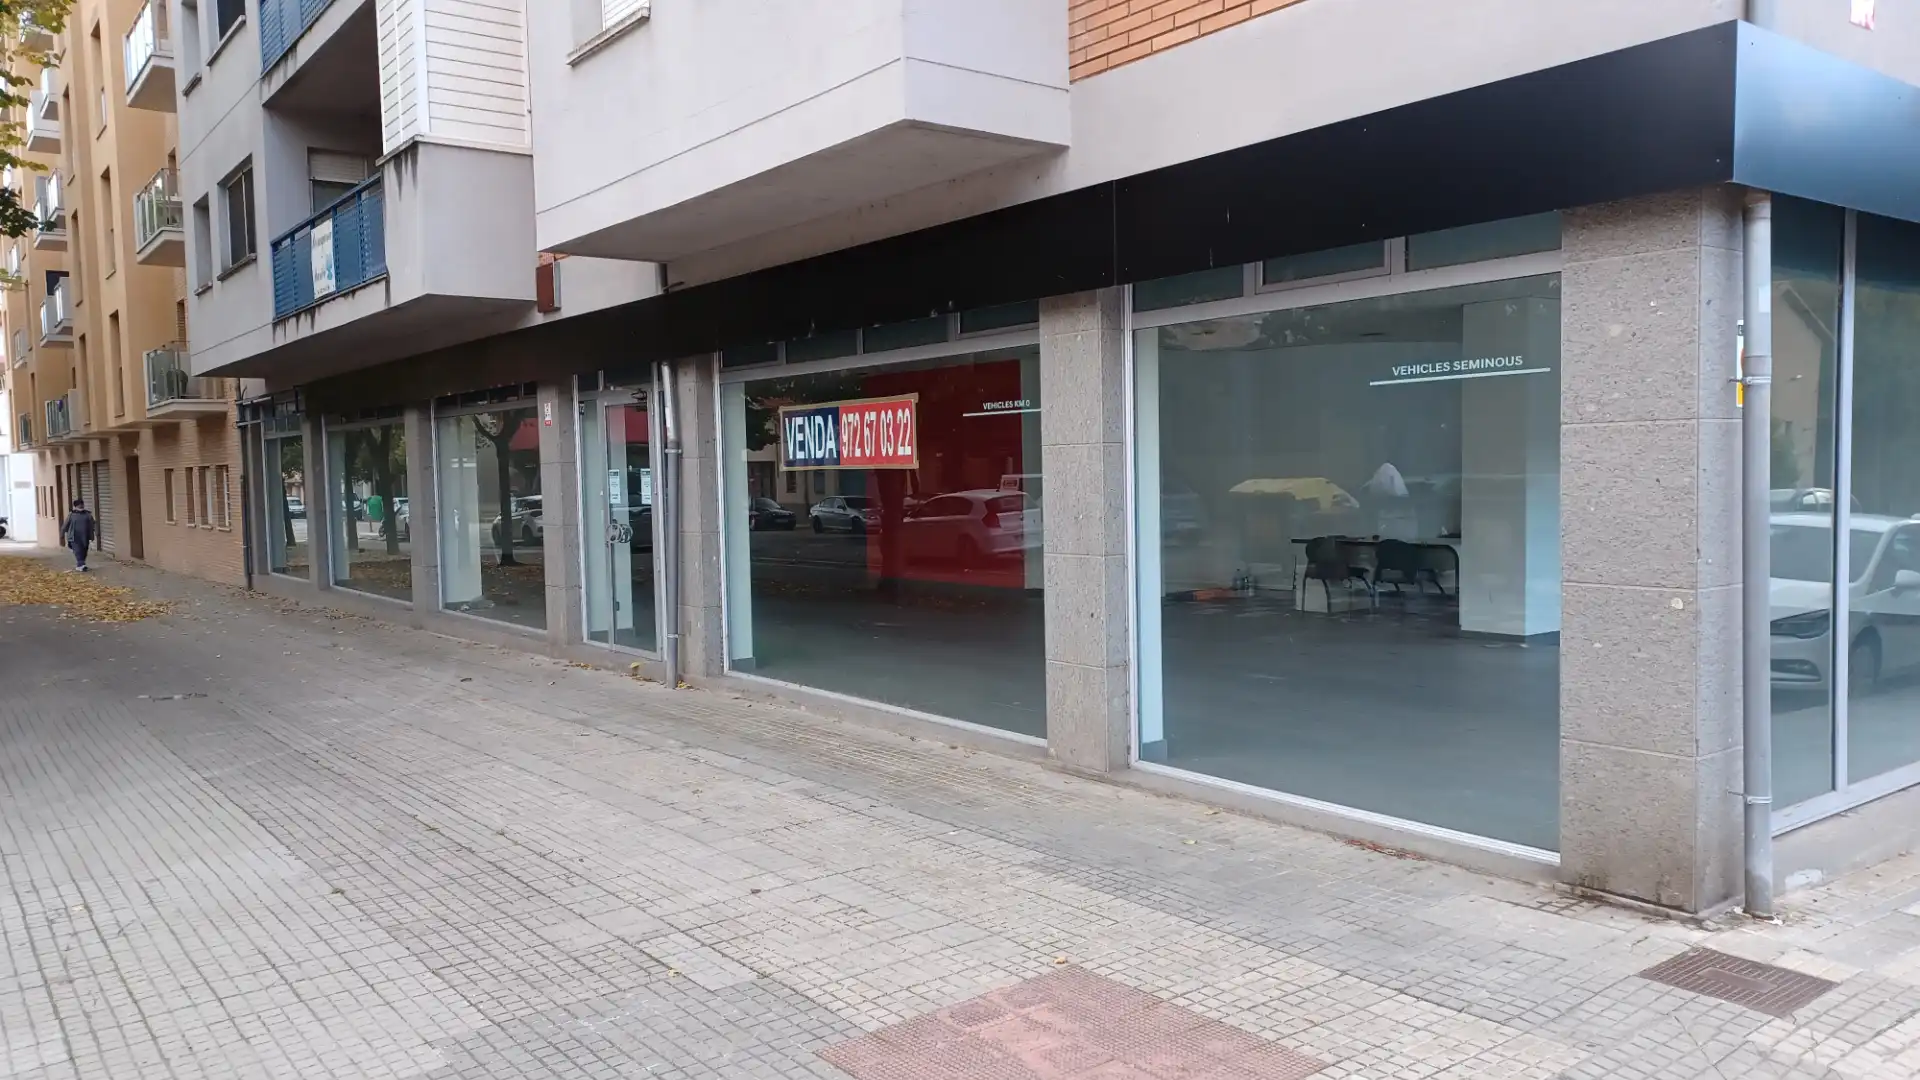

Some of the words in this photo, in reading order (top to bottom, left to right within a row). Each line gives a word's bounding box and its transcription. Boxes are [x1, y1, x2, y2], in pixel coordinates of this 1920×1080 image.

[1392, 362, 1450, 376] VEHICLES
[1453, 356, 1523, 371] SEMINOUS
[983, 401, 1013, 410] VEHICLES
[785, 415, 837, 460] VENDA
[841, 412, 861, 458] 972
[863, 411, 877, 457] 67
[880, 409, 894, 457] 03
[897, 408, 911, 456] 22
